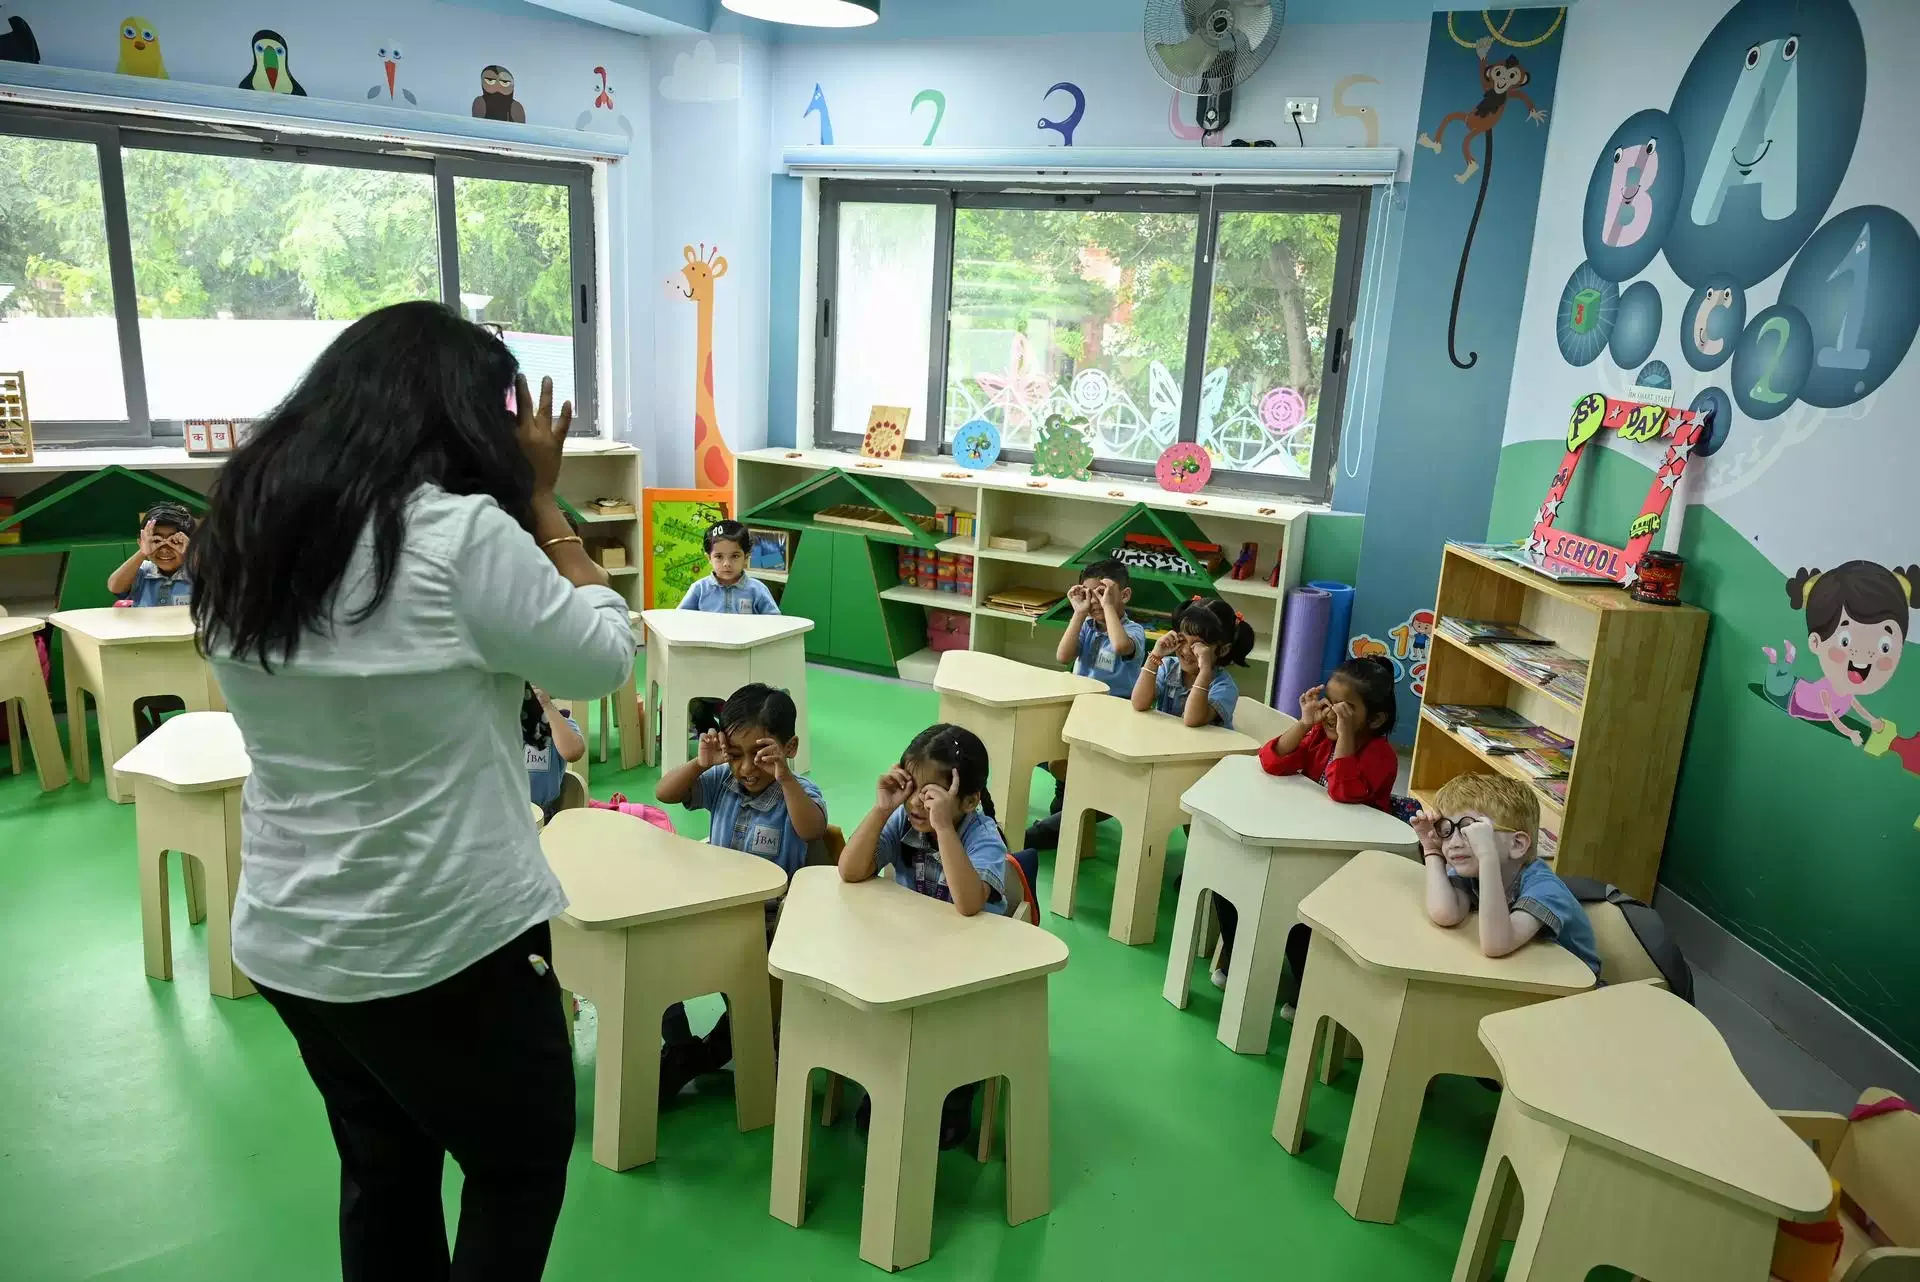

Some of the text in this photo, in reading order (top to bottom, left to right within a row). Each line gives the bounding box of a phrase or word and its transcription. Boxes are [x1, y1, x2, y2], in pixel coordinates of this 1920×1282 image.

[1690, 36, 1799, 226] A
[1602, 141, 1659, 248] B
[1817, 221, 1871, 370] 1
[1693, 287, 1733, 356] C
[1749, 316, 1791, 404] 2
[192, 433, 204, 441] क
[214, 432, 226, 441] ख
[1570, 394, 1664, 441] 1st DAY
[1553, 536, 1619, 576] SCHOOL
[1391, 625, 1409, 657] 1
[526, 750, 547, 764] JBM
[755, 830, 776, 846] JBM
